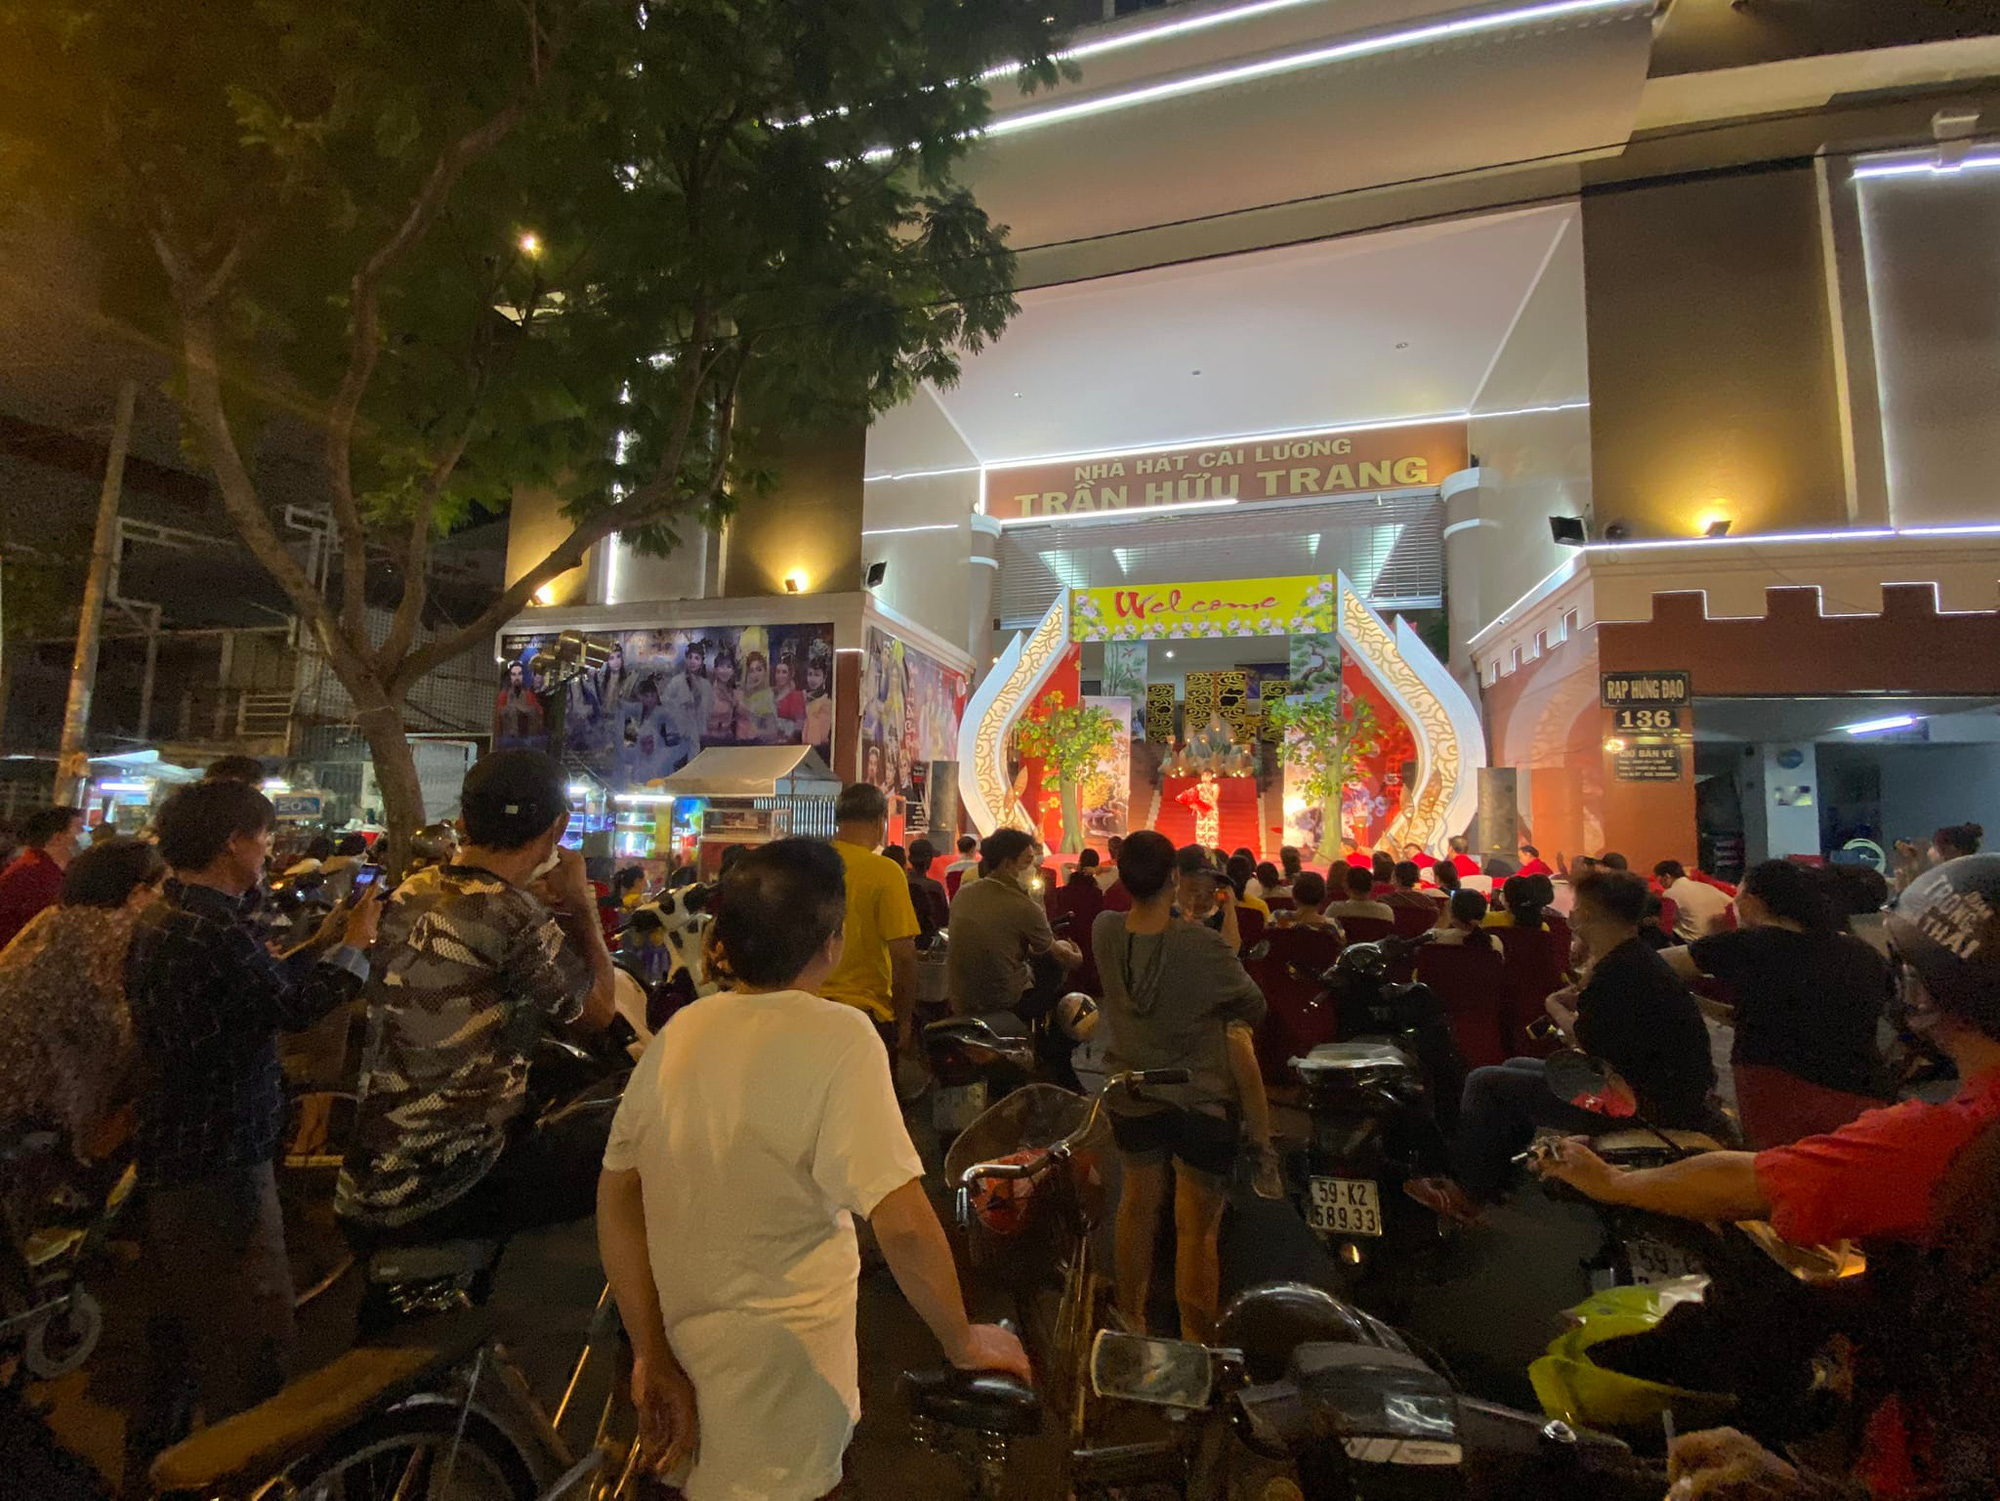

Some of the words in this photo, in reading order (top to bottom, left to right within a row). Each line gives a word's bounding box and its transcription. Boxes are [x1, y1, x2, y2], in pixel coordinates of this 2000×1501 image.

[1074, 458, 1126, 481] NHÀ
[1136, 453, 1189, 475] HÁT
[1255, 438, 1351, 462] LƯƠNG
[1014, 480, 1128, 518] TRẦN
[1145, 472, 1239, 507] HỮU
[1256, 456, 1428, 497] TRANG
[1115, 589, 1281, 619] Welcome
[1621, 710, 1671, 728] 136
[1314, 1204, 1376, 1231] 589.33
